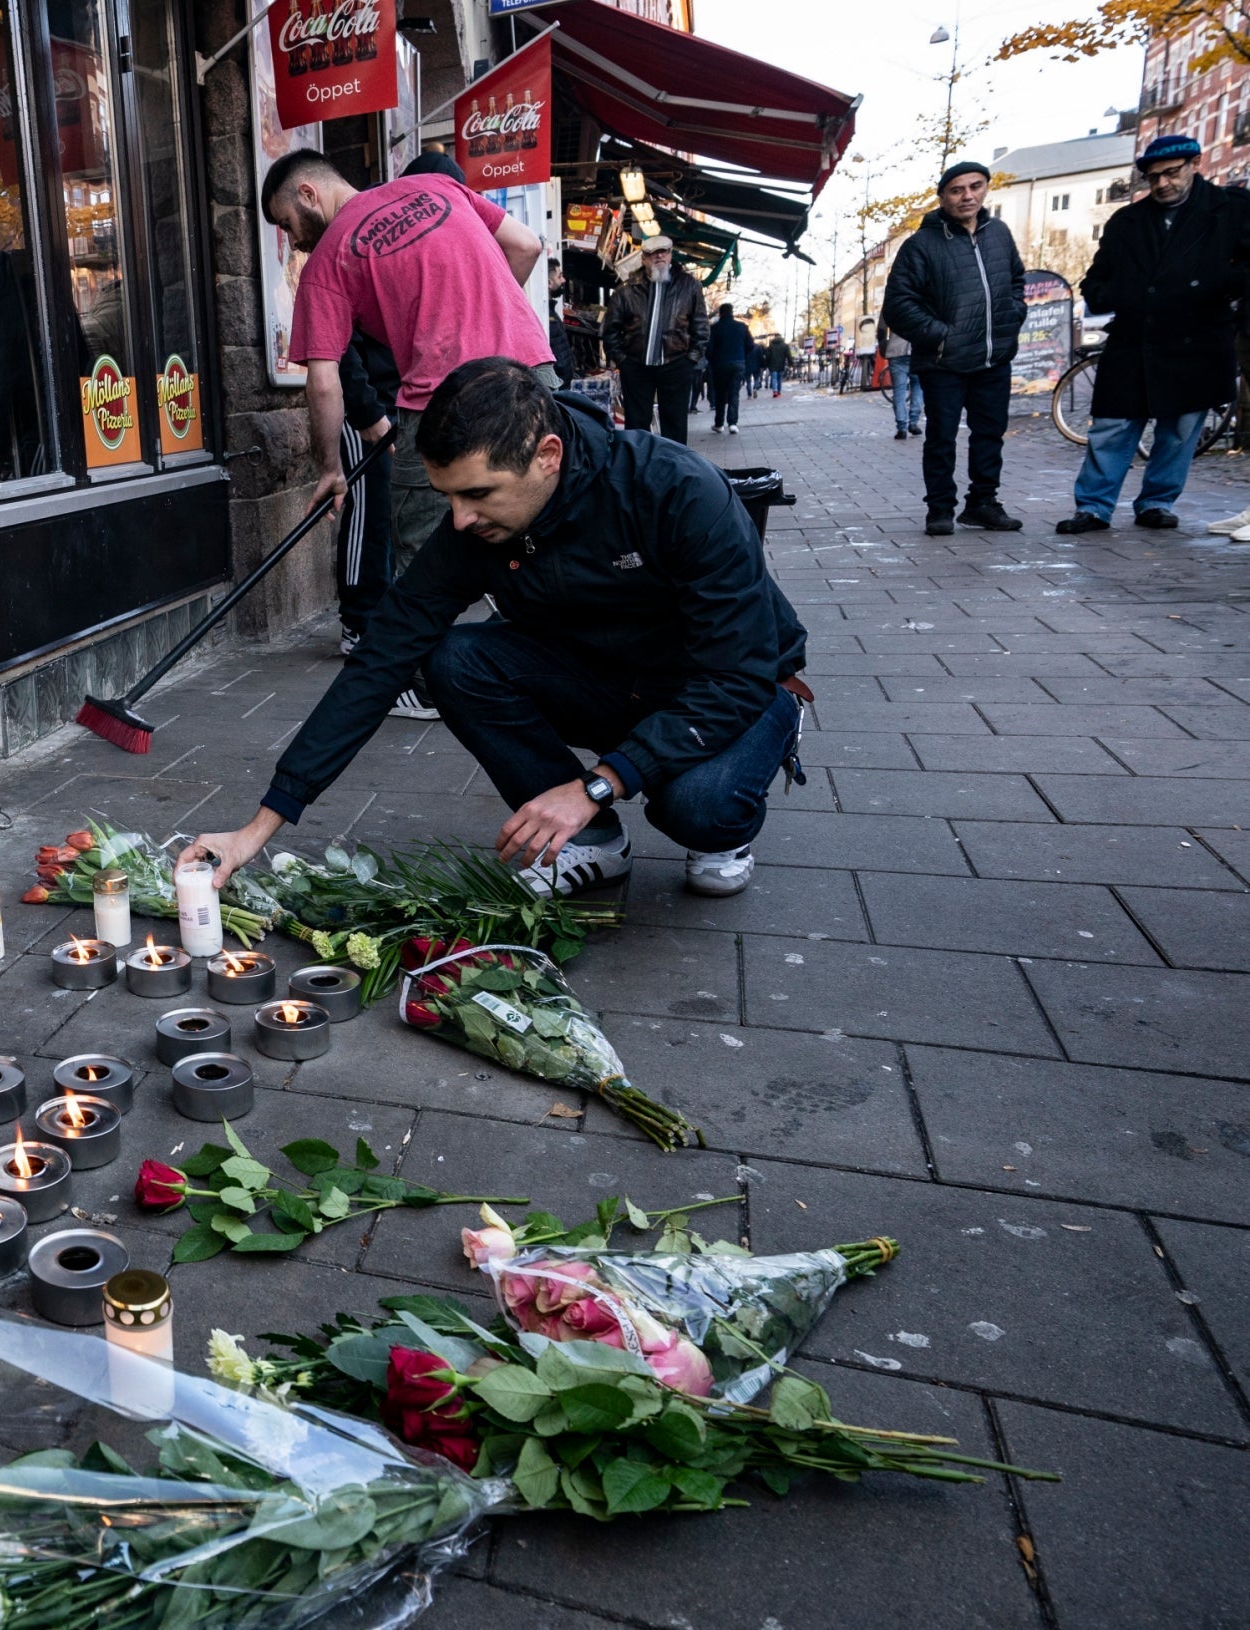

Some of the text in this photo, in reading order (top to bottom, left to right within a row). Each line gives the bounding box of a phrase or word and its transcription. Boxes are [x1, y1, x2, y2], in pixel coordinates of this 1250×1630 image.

[279, 0, 380, 53] Coca-Cola
[306, 78, 361, 103] Öppet
[462, 100, 546, 140] Coca-Cola
[482, 161, 524, 178] Öppet
[358, 192, 434, 246] MÖLLANS
[372, 202, 443, 256] PIZZERIA
[81, 373, 131, 415] Möllans
[157, 370, 195, 407] Möllans
[97, 407, 134, 431] Pizzeria
[168, 400, 197, 422] Pizzeria
